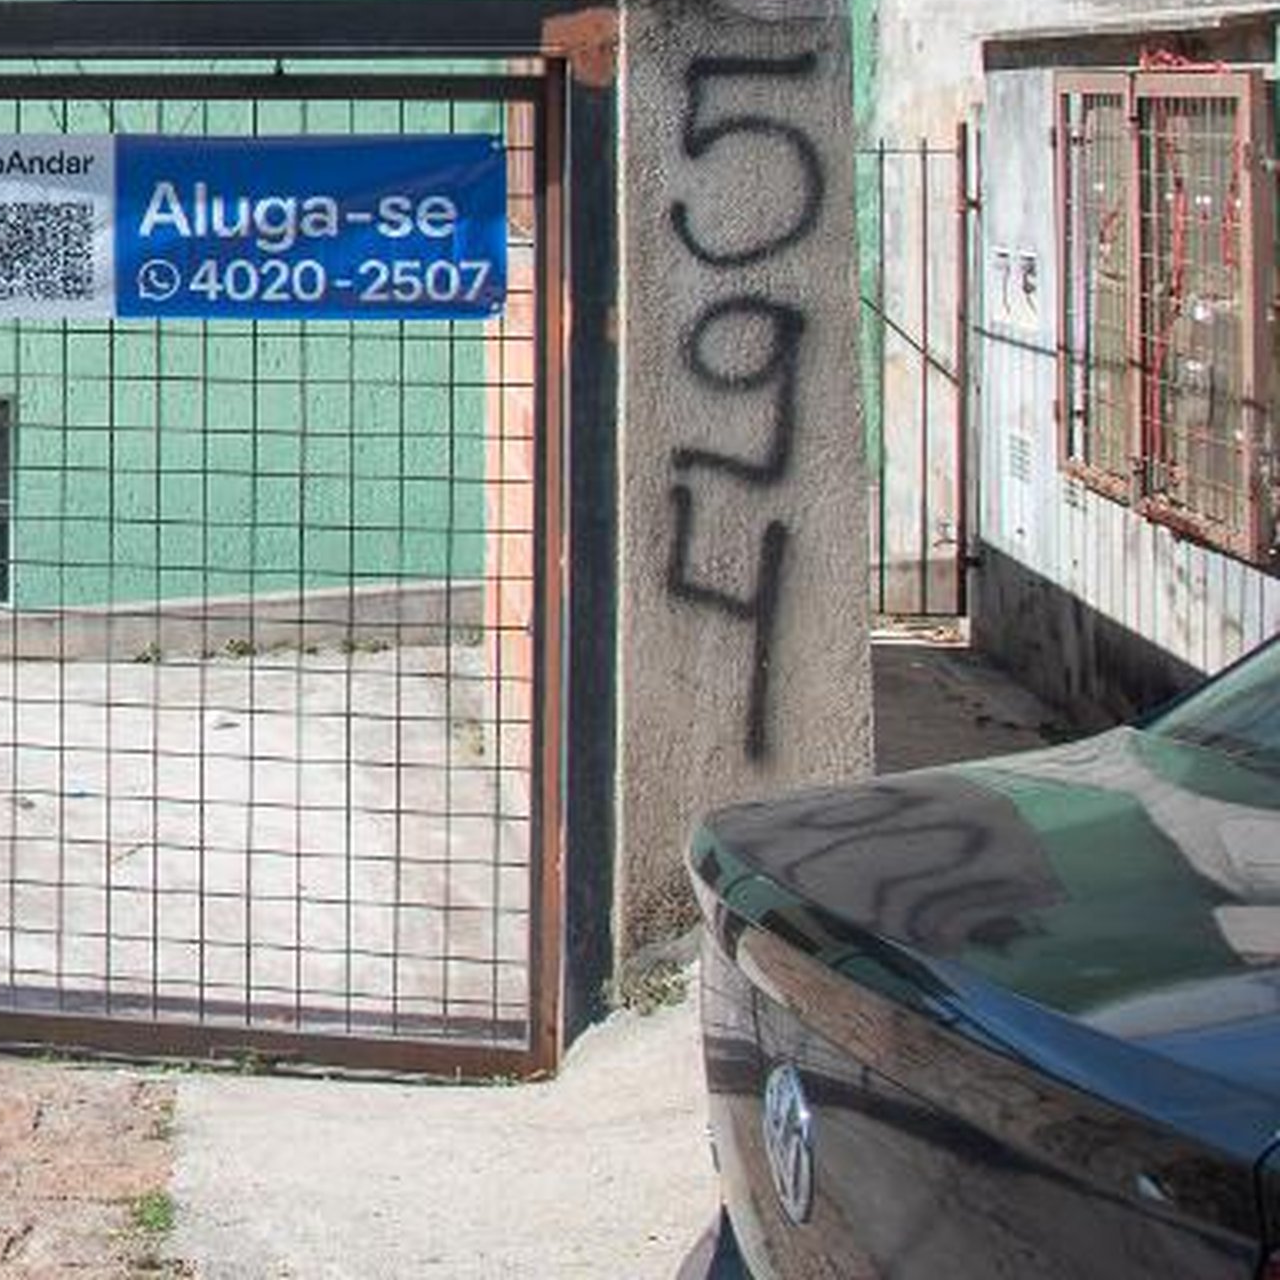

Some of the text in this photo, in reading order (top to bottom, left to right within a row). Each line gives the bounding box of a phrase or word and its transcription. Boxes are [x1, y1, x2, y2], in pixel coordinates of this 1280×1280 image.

[138, 181, 457, 253] Aluga-se
[188, 258, 493, 303] 4020-2507
[670, 51, 827, 763] 594
